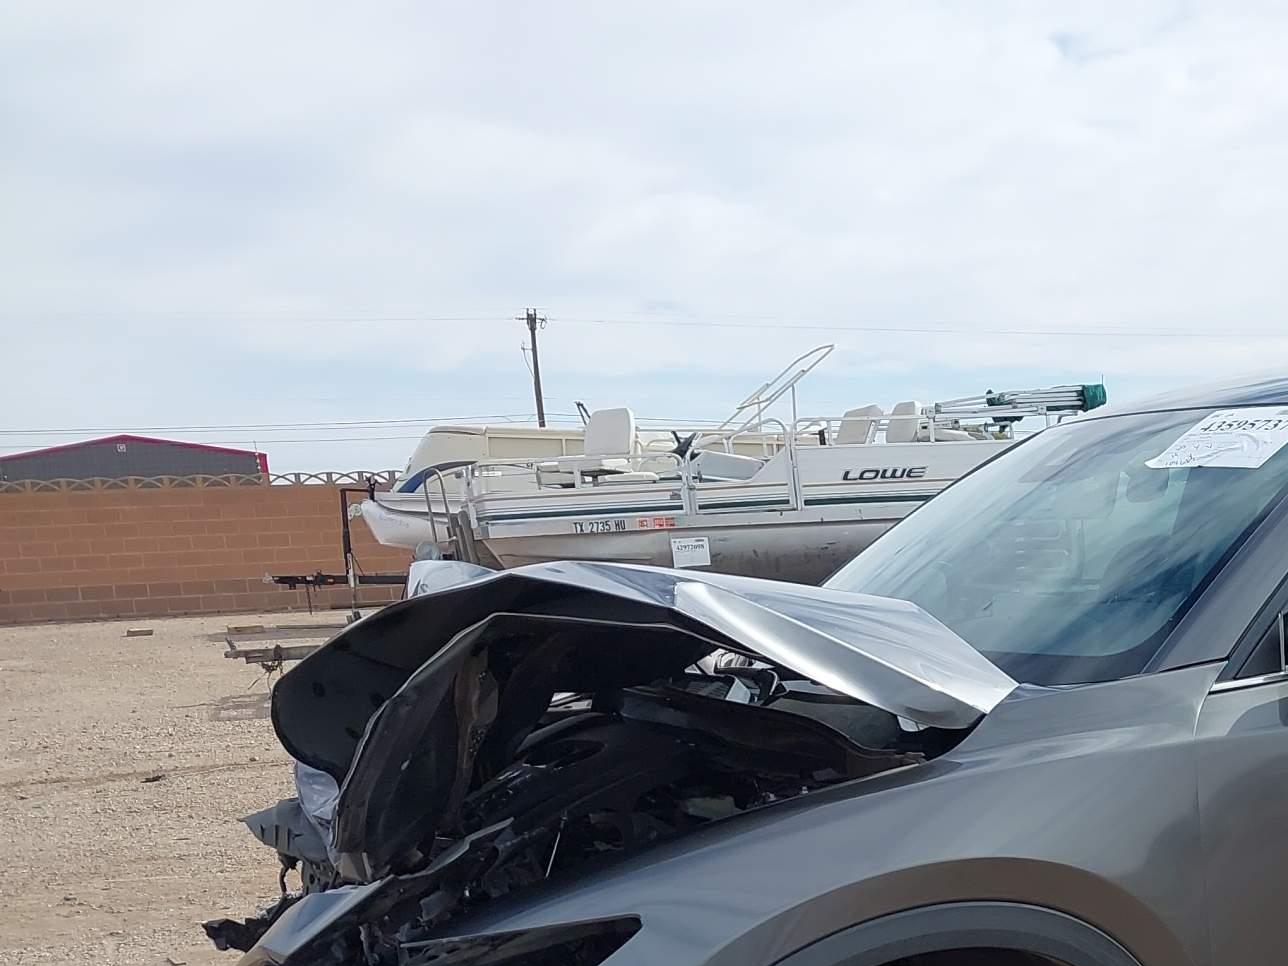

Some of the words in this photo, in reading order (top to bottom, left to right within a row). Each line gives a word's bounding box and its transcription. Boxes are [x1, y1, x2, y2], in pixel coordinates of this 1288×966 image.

[842, 466, 927, 481] LOWE
[573, 521, 585, 534] TX
[589, 520, 611, 534] 2735
